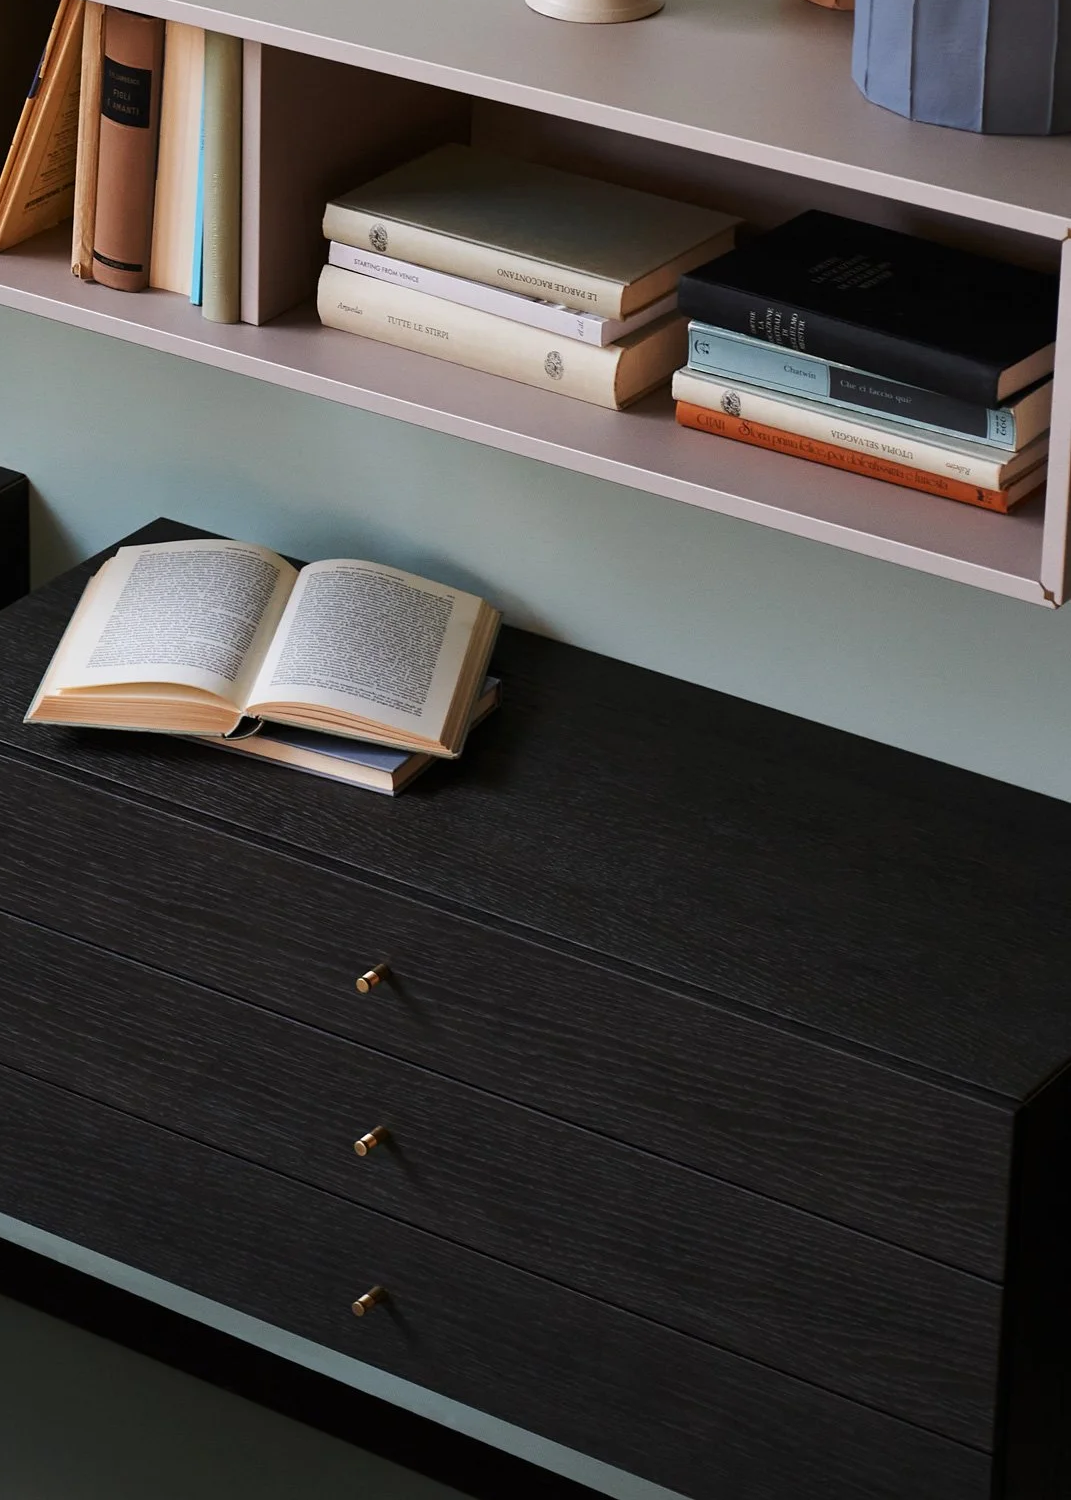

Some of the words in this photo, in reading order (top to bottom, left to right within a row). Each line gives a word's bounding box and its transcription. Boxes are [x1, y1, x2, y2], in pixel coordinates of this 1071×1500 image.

[354, 259, 381, 272] STARTING
[381, 266, 398, 277] FROM
[399, 271, 419, 283] VENICE
[496, 268, 553, 290] RACCONTANO
[554, 283, 586, 299] PAROLE
[588, 291, 598, 301] LE
[388, 316, 412, 329] TUTTE
[413, 323, 423, 333] LE
[425, 327, 449, 340] STIRPI
[783, 364, 817, 380] Chatwin
[840, 380, 857, 390] Che
[869, 387, 894, 400] faccio
[895, 394, 913, 405] qui?
[831, 430, 879, 451] SELVAGGIA
[881, 443, 914, 460] UTOPIA
